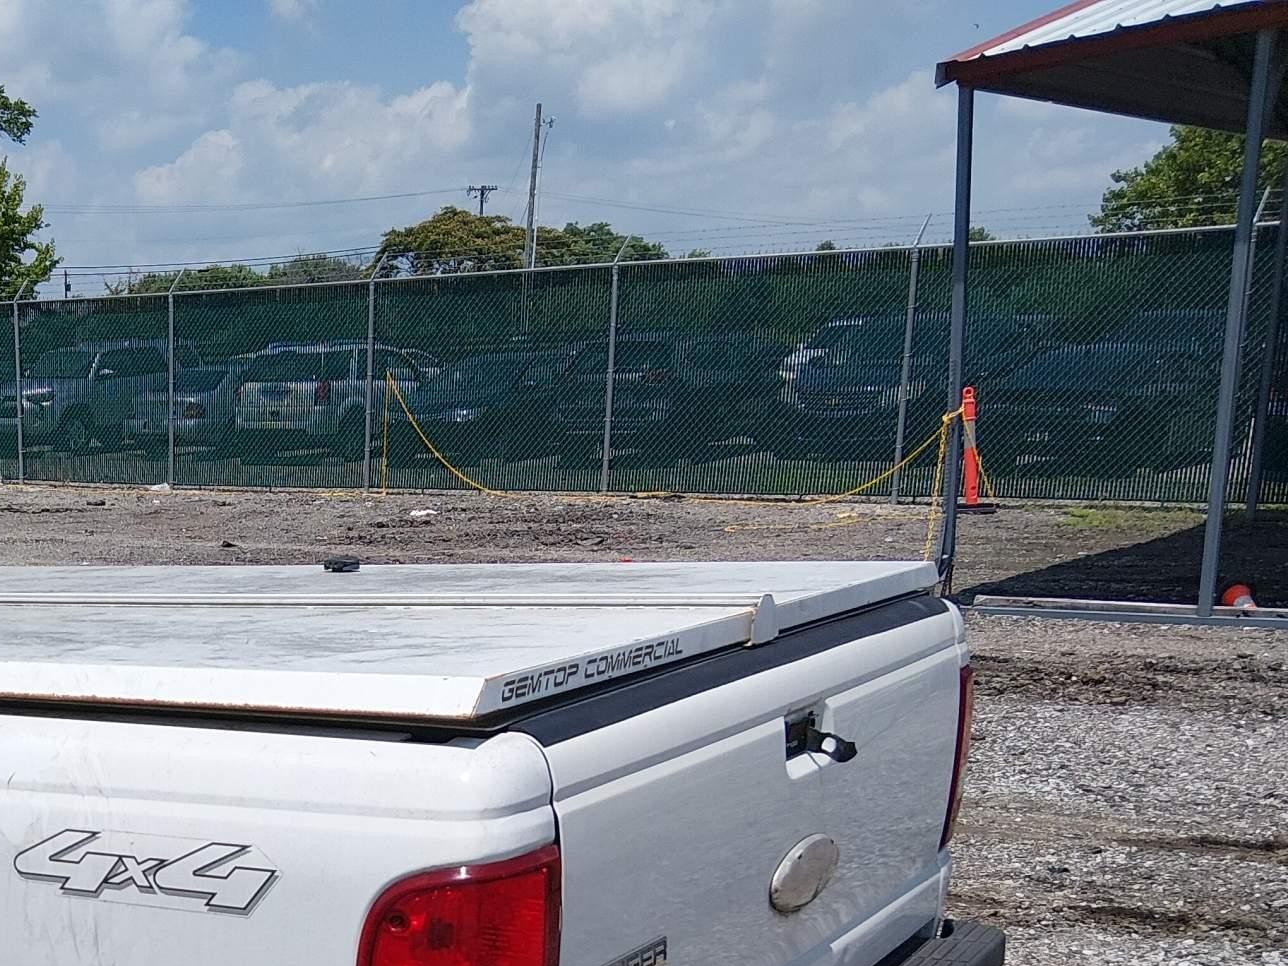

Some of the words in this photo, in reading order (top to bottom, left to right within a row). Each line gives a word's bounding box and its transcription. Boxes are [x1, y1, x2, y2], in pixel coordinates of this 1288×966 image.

[501, 664, 579, 703] GEMTOP
[584, 638, 684, 679] COMMERCIAL
[13, 828, 281, 917] 4x4
